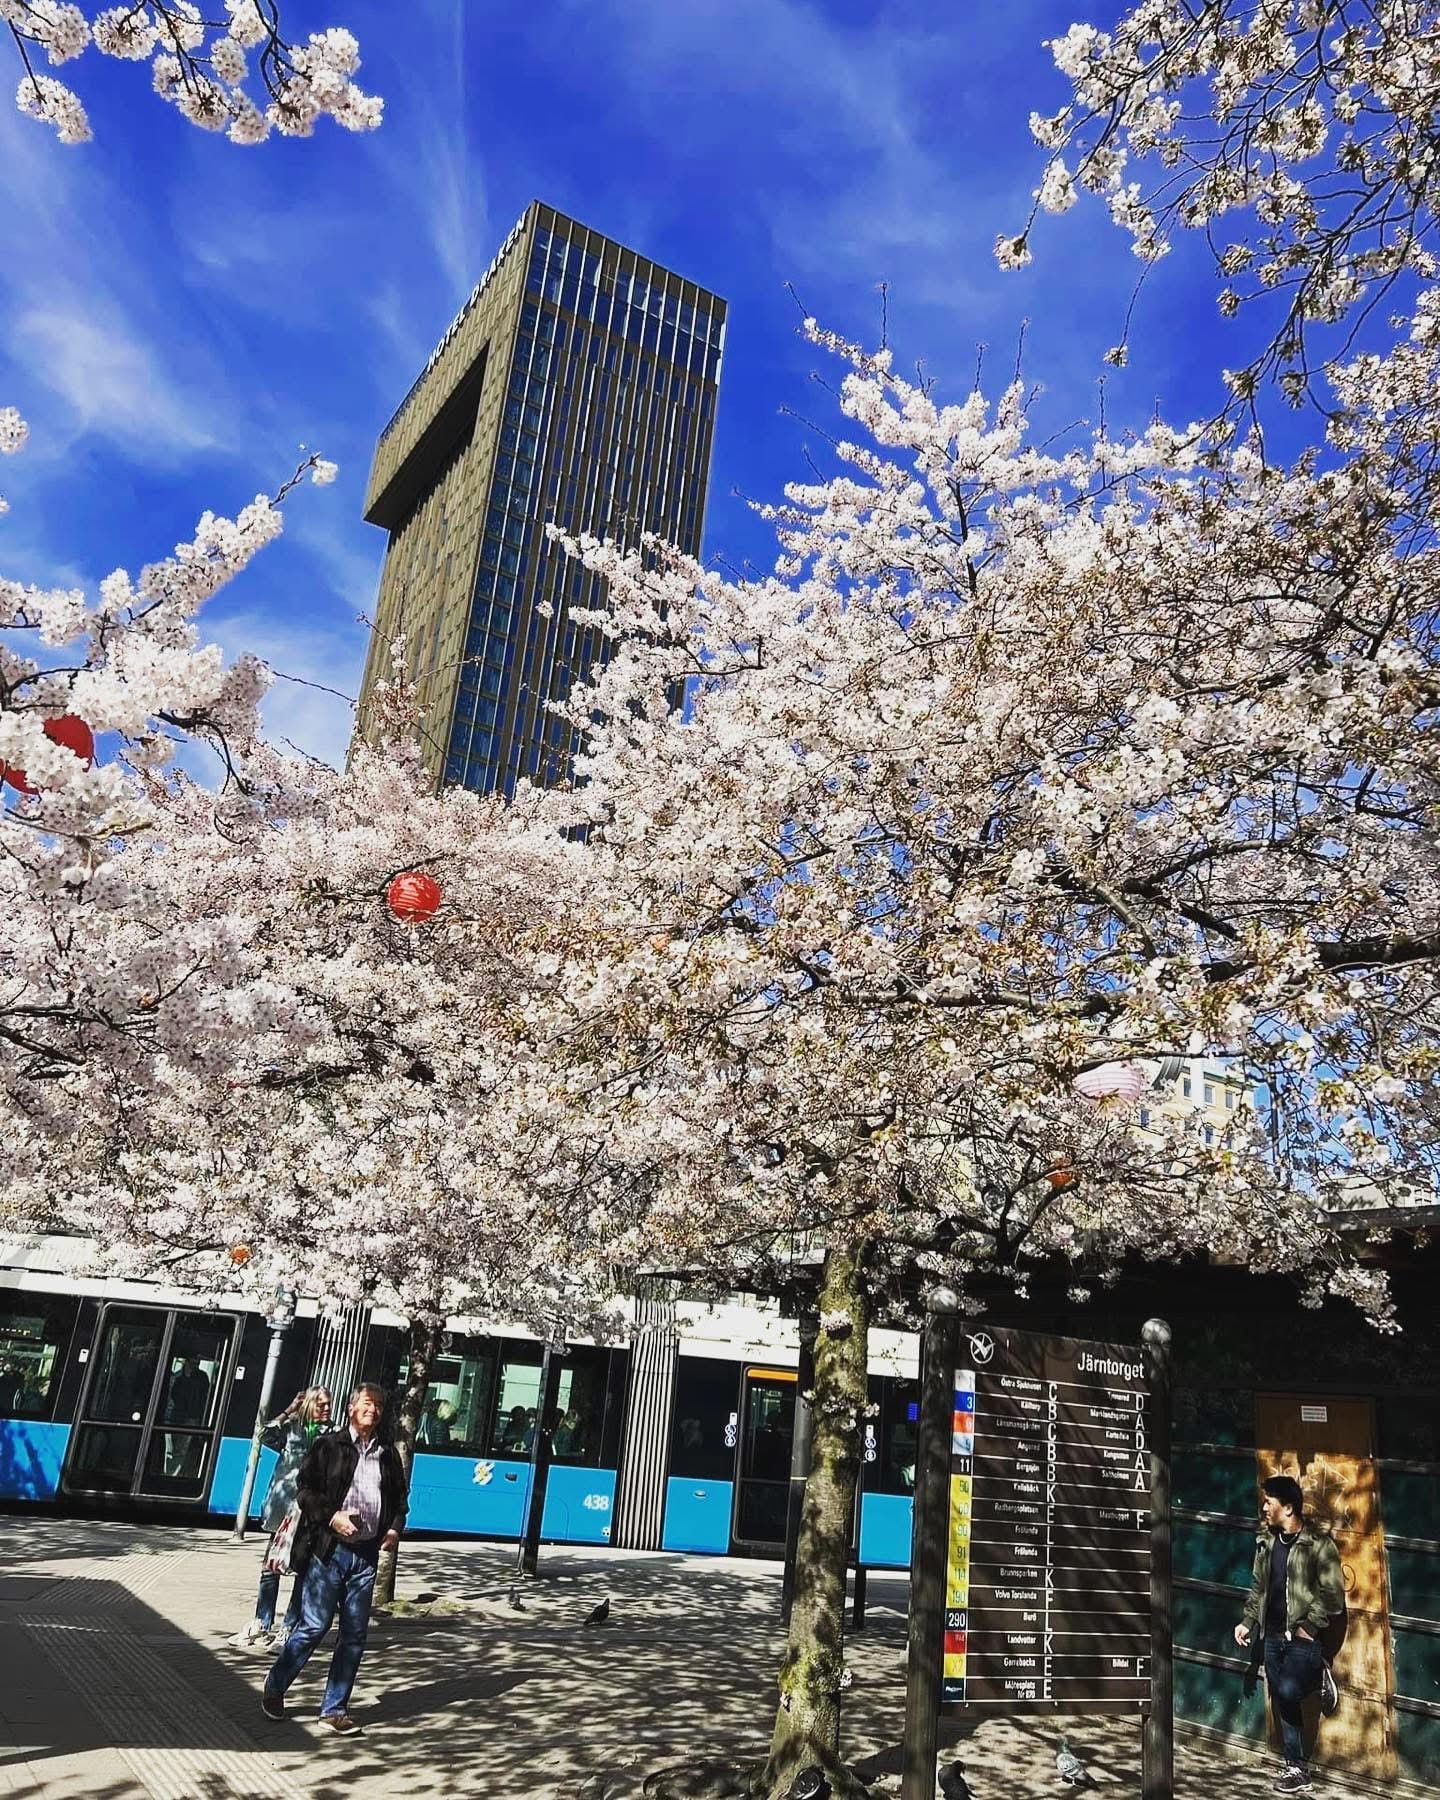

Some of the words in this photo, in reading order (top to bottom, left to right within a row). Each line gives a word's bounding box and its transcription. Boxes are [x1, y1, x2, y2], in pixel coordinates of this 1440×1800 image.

[1077, 1352, 1145, 1380] Järntorget
[1048, 1383, 1057, 1400] C
[966, 1396, 973, 1409] 3
[1048, 1402, 1057, 1420] B
[1135, 1394, 1144, 1410] D
[1047, 1422, 1056, 1441] C
[1135, 1413, 1145, 1431] A
[1135, 1432, 1145, 1450] D
[1047, 1443, 1056, 1461] B
[1134, 1452, 1145, 1470] A
[960, 1458, 970, 1473] 11
[1047, 1463, 1056, 1481] B
[1134, 1472, 1145, 1490] A
[583, 1494, 609, 1510] 438
[1046, 1484, 1056, 1503] K
[1046, 1505, 1055, 1523] E
[1136, 1511, 1145, 1530] F
[1046, 1526, 1054, 1545] L
[957, 1546, 966, 1559] 91
[1046, 1547, 1054, 1566] L
[1045, 1568, 1054, 1588] K
[994, 1589, 1011, 1600] Volvo
[1011, 1589, 1037, 1600] Torslanda
[1045, 1589, 1053, 1609] F
[948, 1612, 966, 1628] 290
[1044, 1611, 1053, 1632] L
[1043, 1634, 1053, 1654] K
[1044, 1656, 1052, 1676] E
[1136, 1658, 1145, 1677] F
[1043, 1679, 1052, 1699] E
